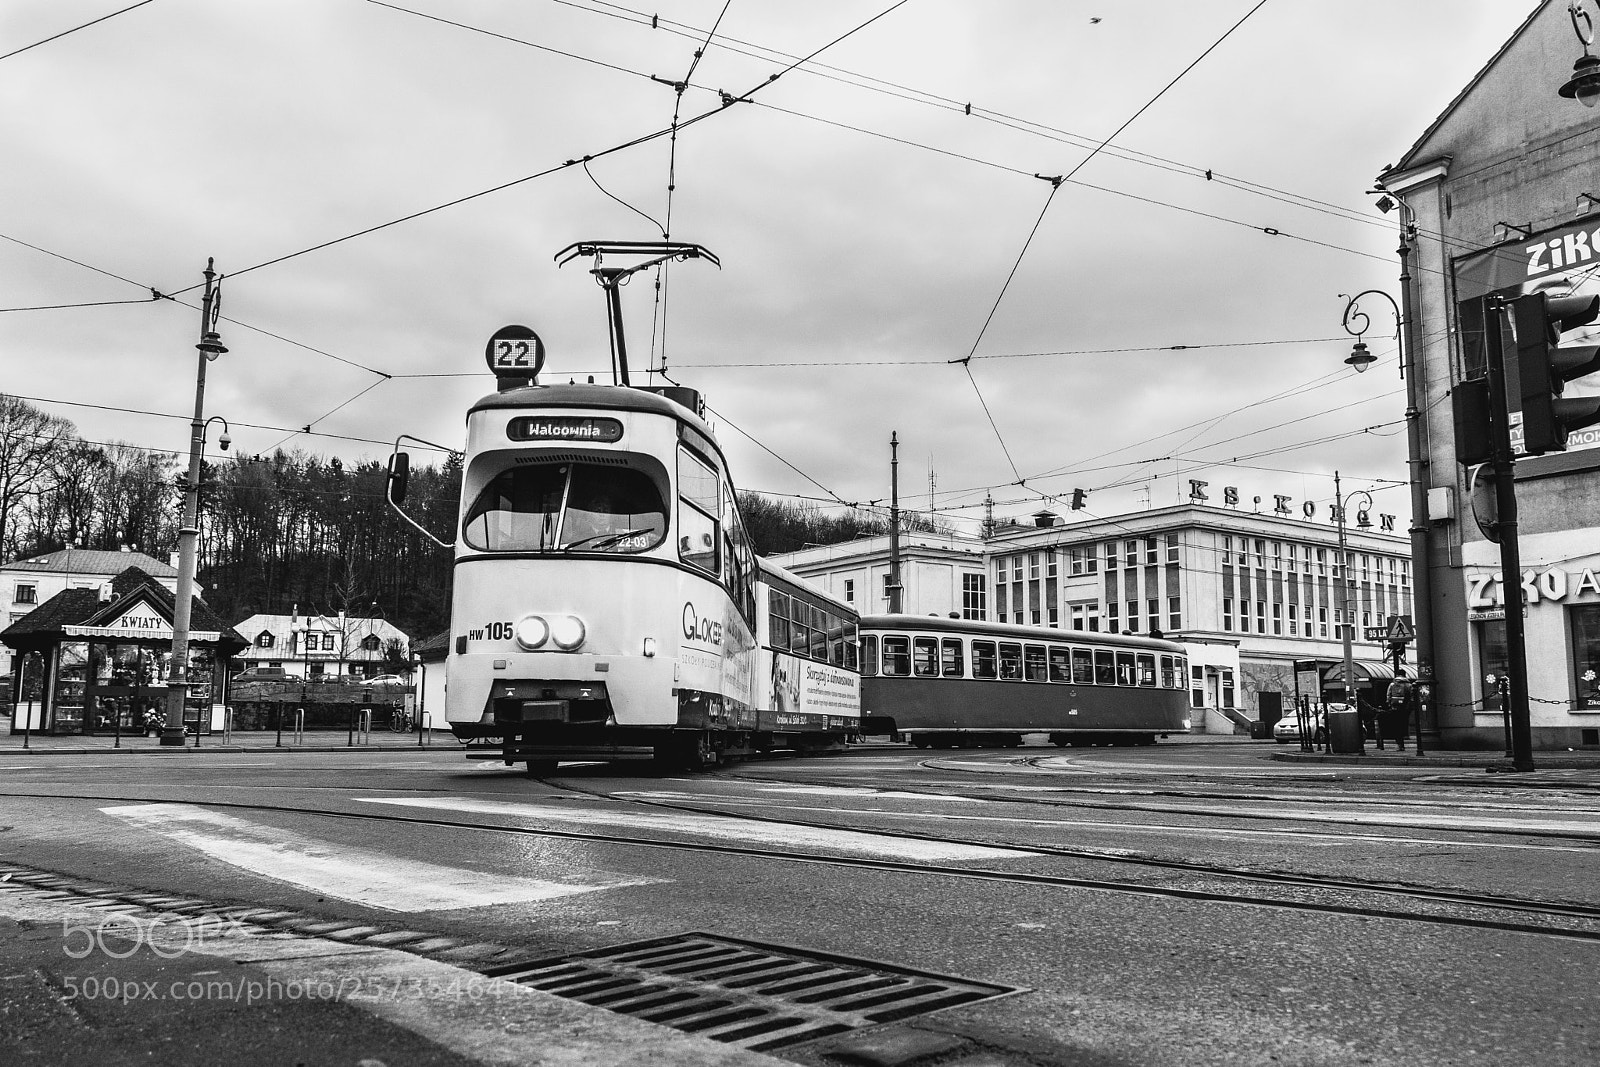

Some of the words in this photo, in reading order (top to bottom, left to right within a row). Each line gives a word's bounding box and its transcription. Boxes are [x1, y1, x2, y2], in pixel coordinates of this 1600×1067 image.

[497, 341, 529, 366] 22
[529, 423, 600, 436] Walcownia
[121, 616, 162, 629] KWIATY
[469, 630, 484, 640] HW
[485, 622, 514, 640] 105
